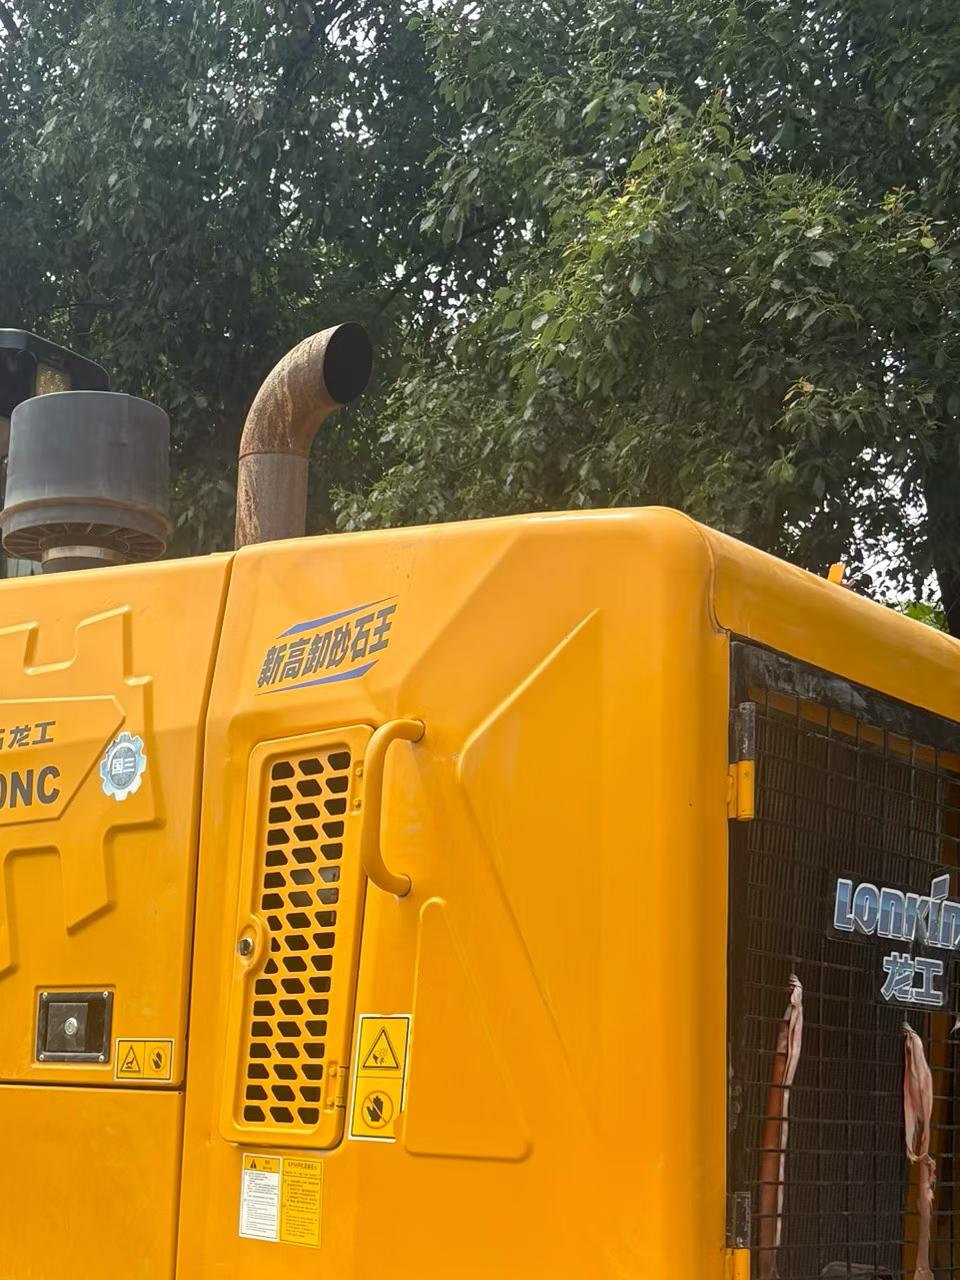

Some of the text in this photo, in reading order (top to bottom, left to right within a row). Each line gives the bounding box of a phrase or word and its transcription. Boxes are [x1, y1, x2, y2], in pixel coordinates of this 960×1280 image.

[256, 604, 397, 688] 新高卸砂石王
[8, 721, 56, 749] 龙工
[880, 952, 944, 1006] 龙工
